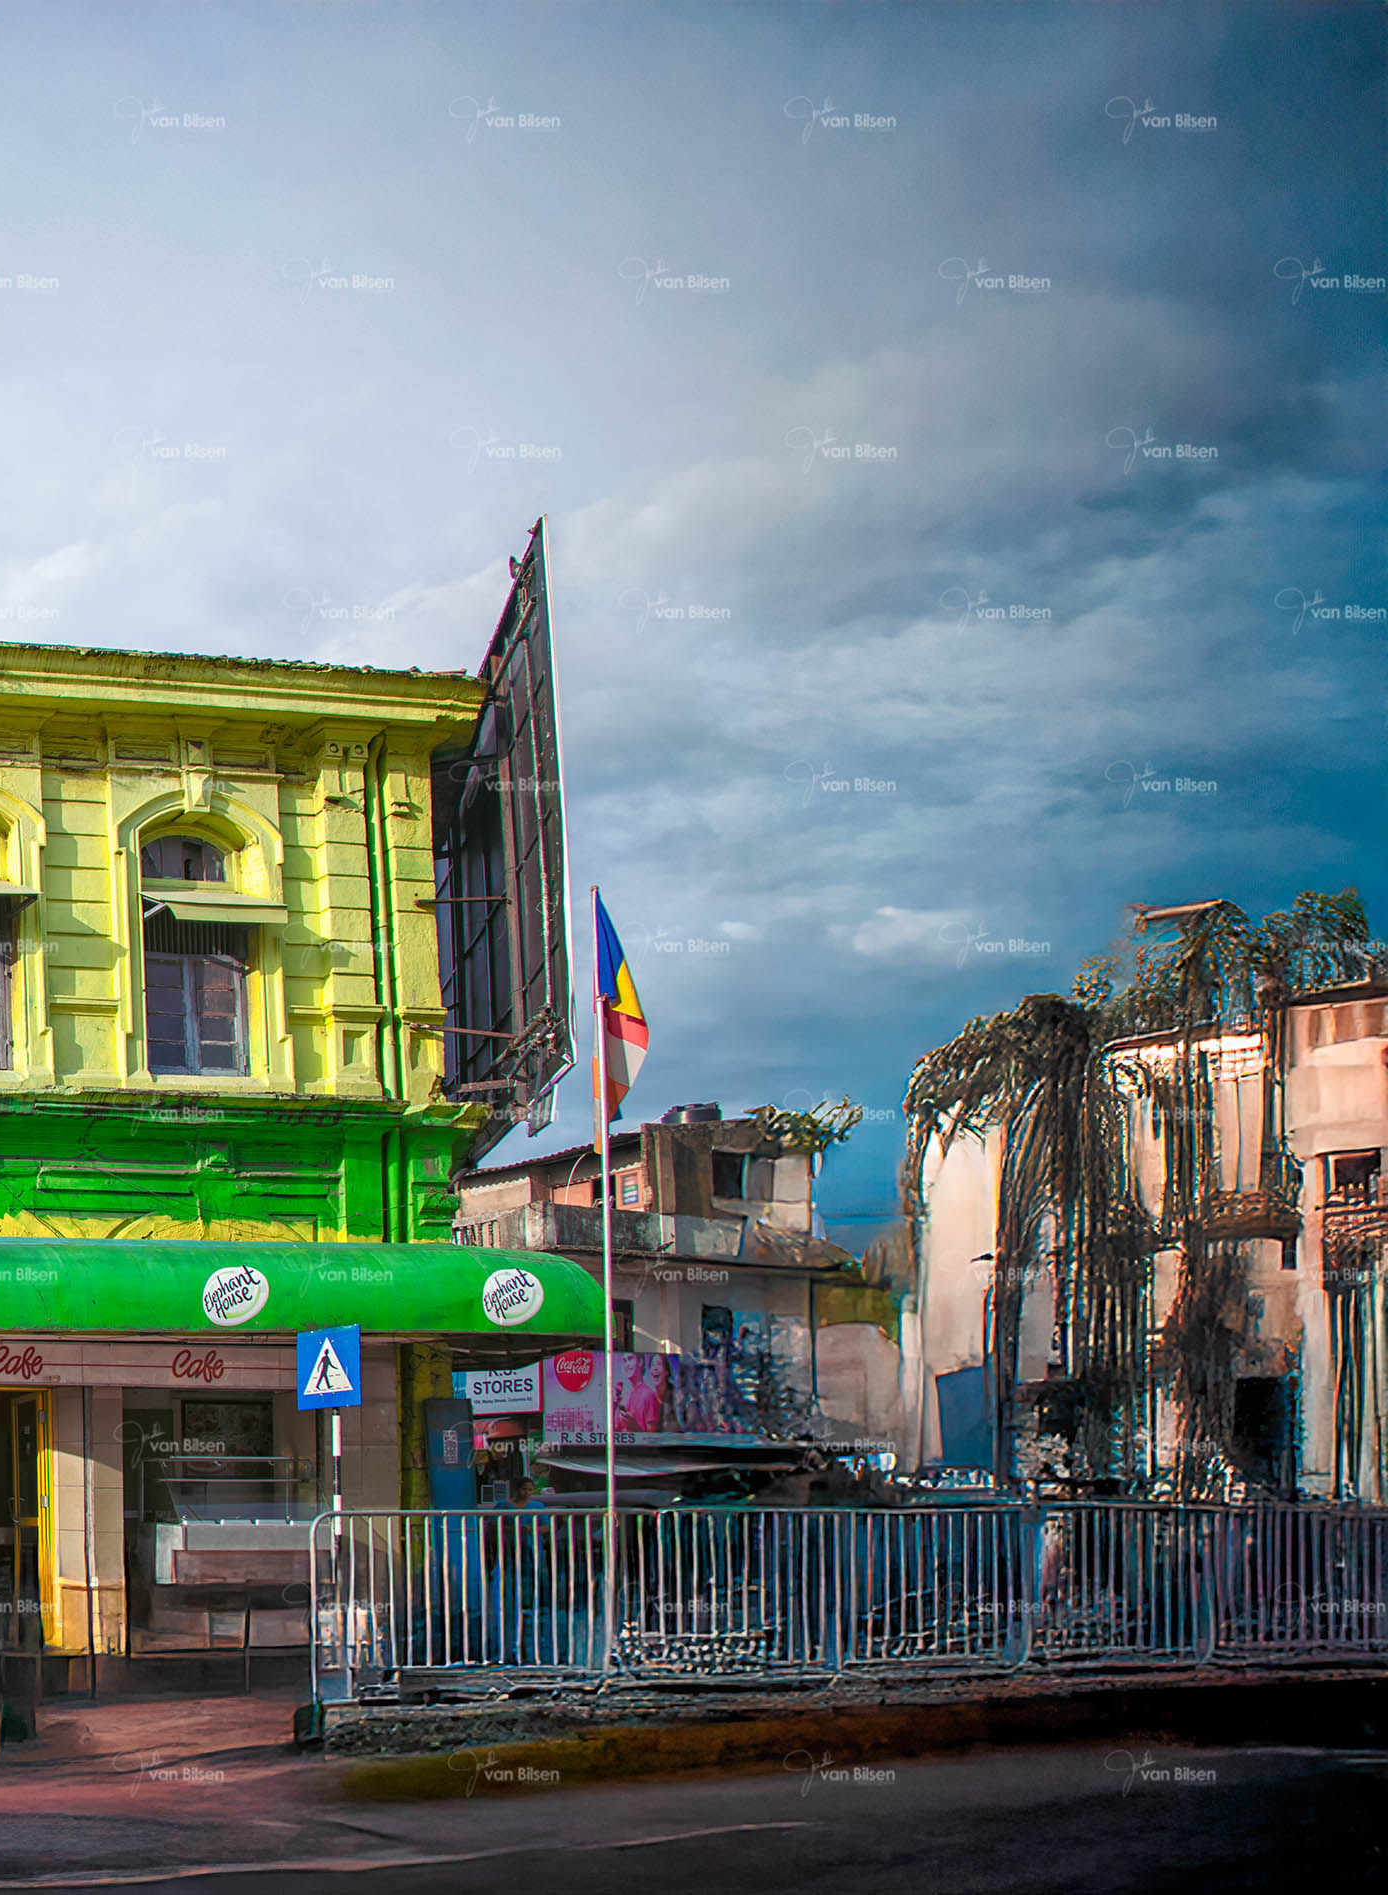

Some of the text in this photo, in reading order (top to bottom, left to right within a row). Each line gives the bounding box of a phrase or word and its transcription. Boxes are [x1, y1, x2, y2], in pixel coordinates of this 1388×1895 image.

[203, 1264, 261, 1312] Elephant
[214, 1286, 253, 1319] House
[483, 1268, 535, 1312] Elephant
[494, 1288, 529, 1319] House
[171, 1349, 224, 1383] Cafe
[472, 1377, 533, 1395] STORES
[560, 1432, 572, 1443] R.
[575, 1432, 587, 1443] S.
